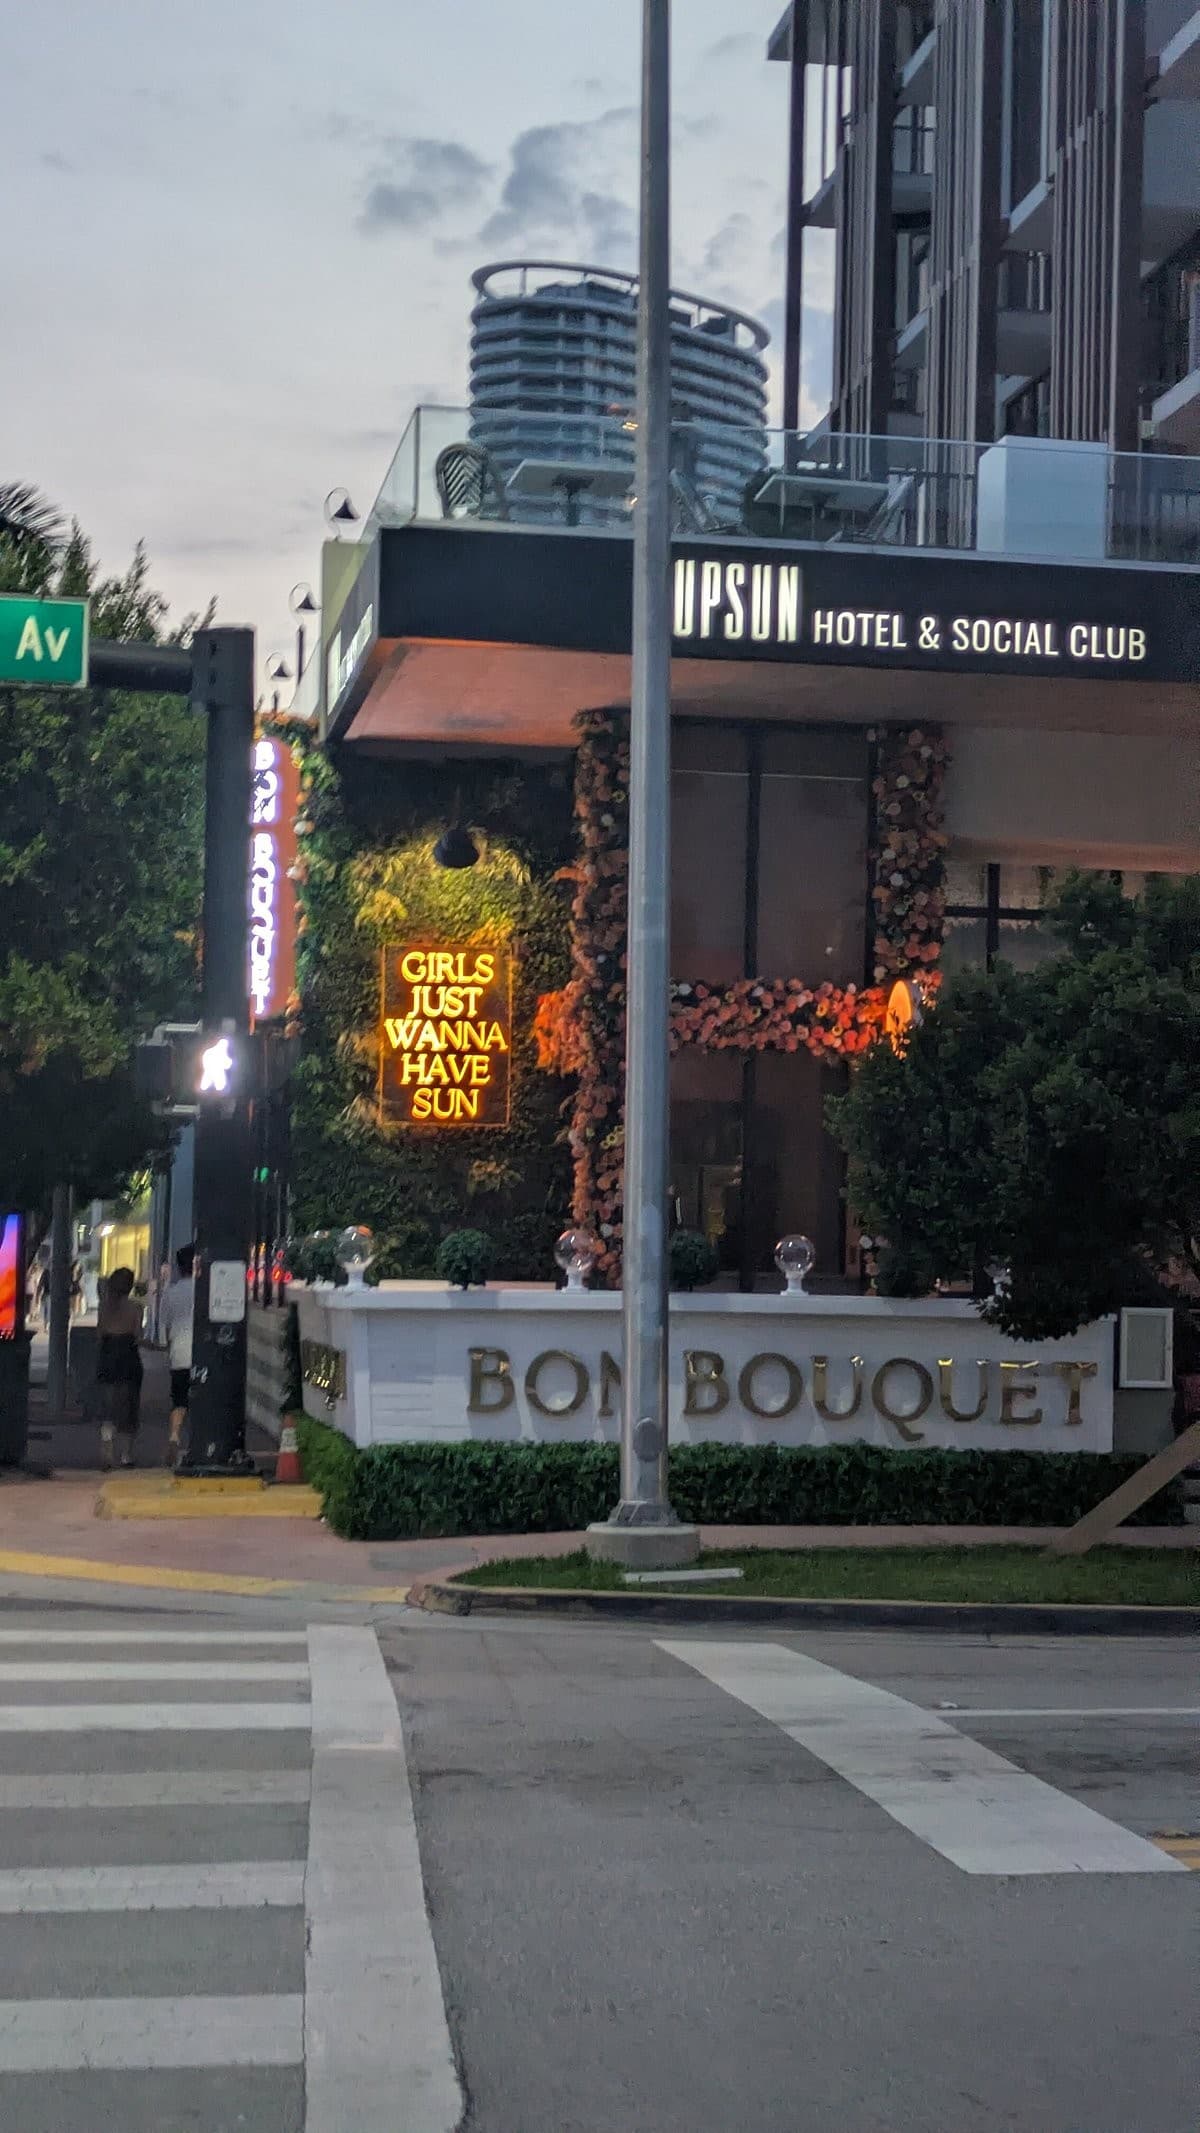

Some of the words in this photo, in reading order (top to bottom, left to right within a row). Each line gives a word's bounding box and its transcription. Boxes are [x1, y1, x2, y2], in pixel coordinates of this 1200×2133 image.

[673, 559, 800, 643] UPSUN
[813, 609, 907, 648] HOTEL
[918, 616, 940, 650] &
[952, 618, 1059, 656] SOCIAL
[1070, 625, 1147, 661] CLUB
[401, 952, 495, 985] GIRLS
[406, 985, 484, 1020] JUST
[383, 1018, 509, 1052] WANNA
[400, 1053, 491, 1086] HAVE
[411, 1087, 480, 1120] SUN
[683, 1350, 1098, 1442] BOUQUET
